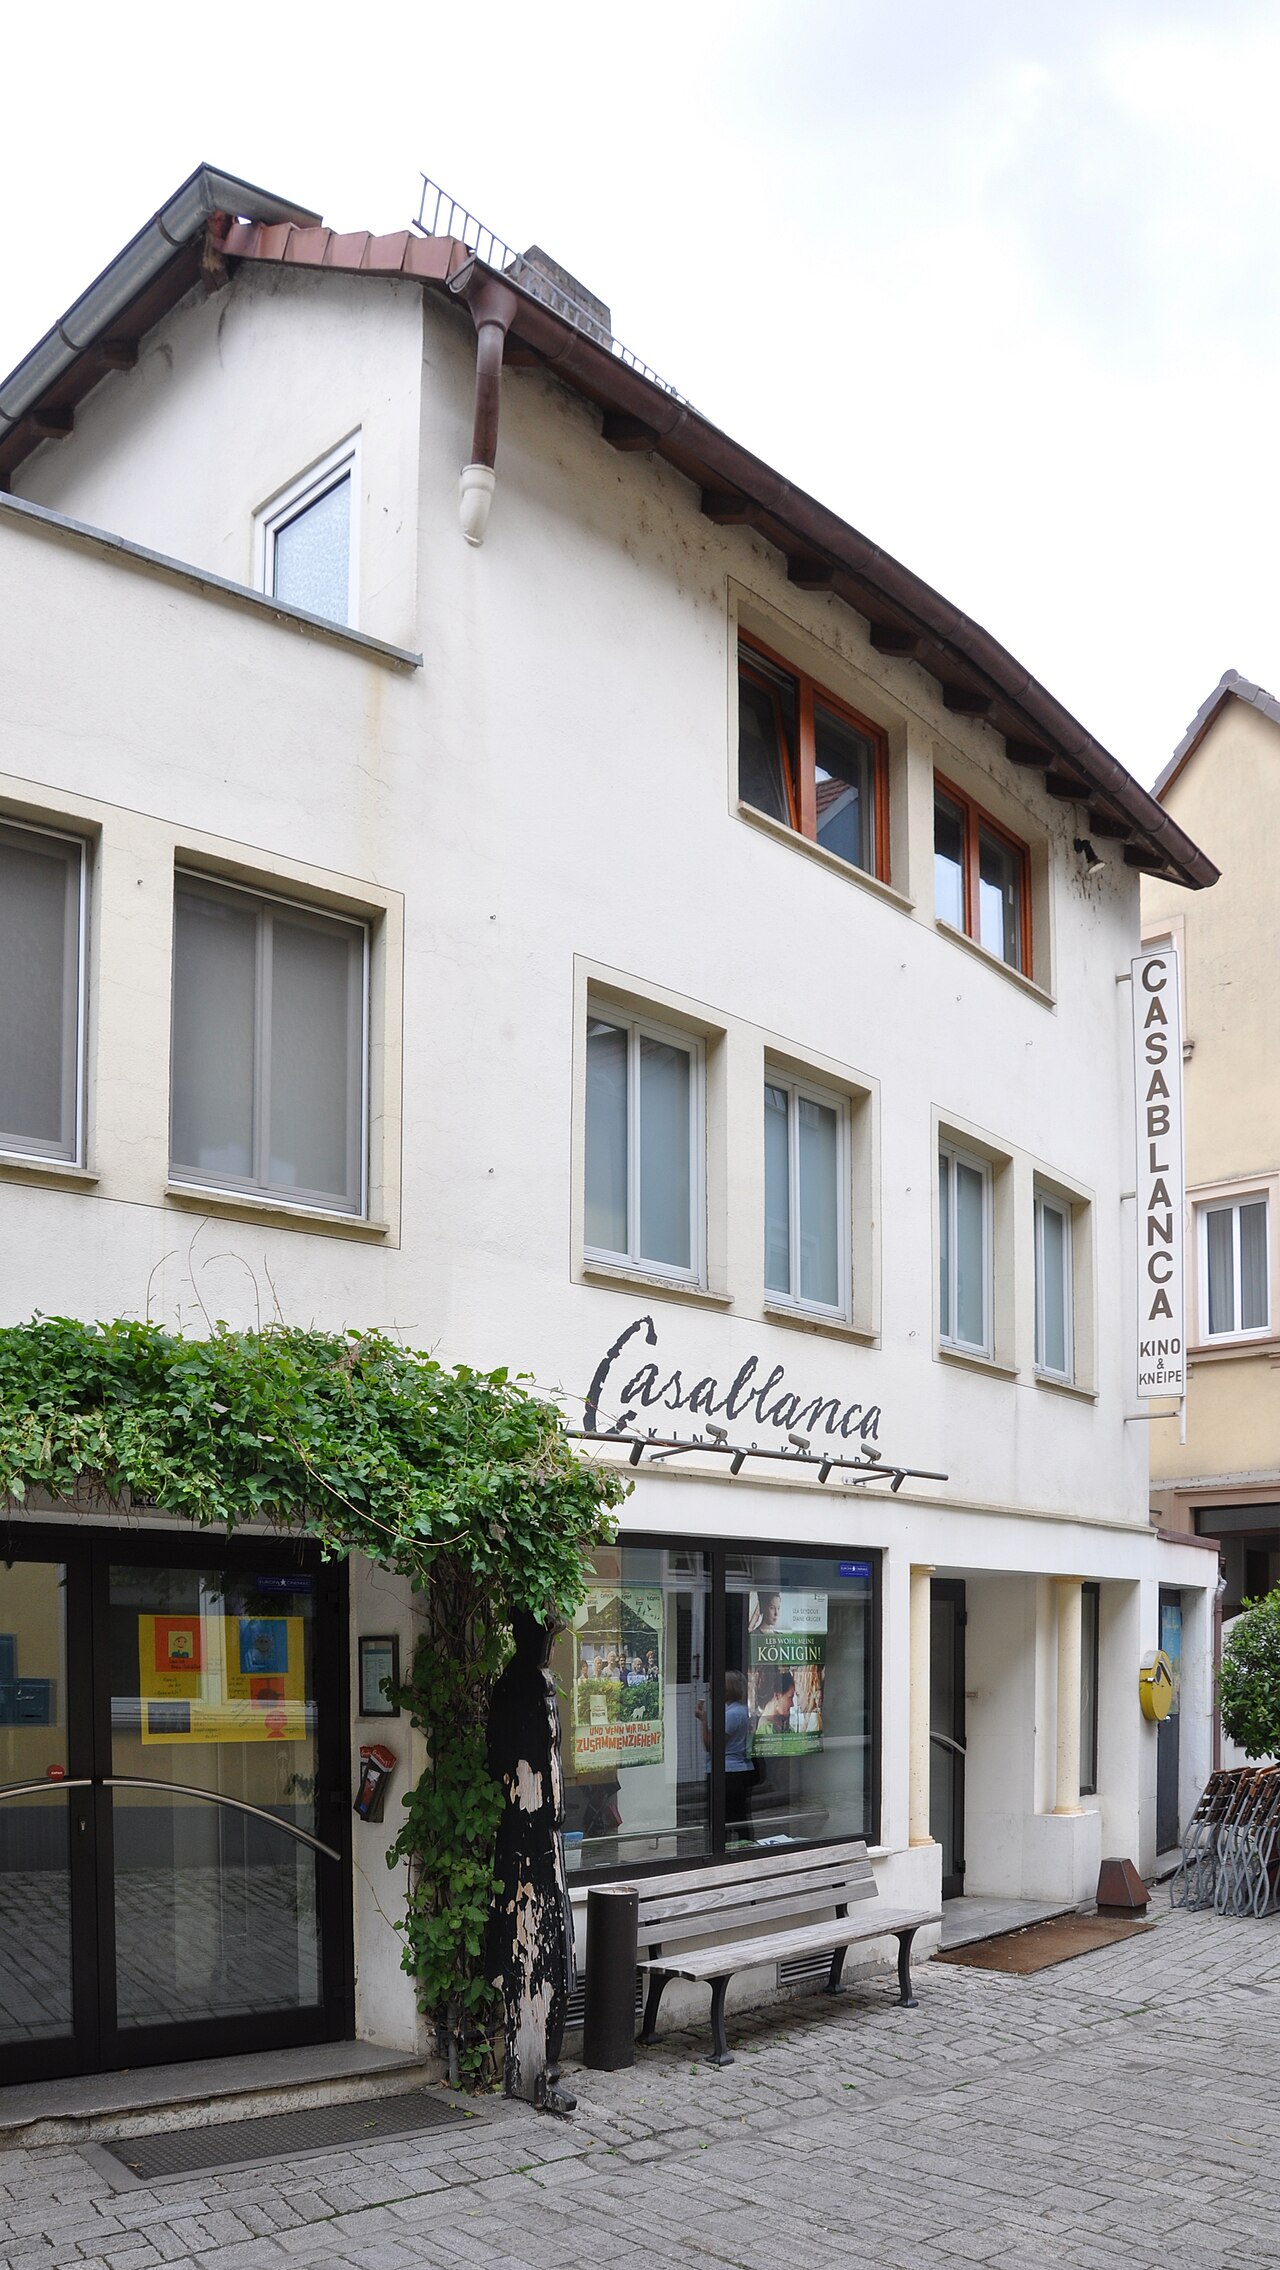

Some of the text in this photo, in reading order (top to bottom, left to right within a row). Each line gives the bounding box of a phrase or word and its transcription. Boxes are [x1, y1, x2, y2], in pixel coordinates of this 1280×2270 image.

[1141, 959, 1174, 1321] CASABLANCA
[1139, 1337, 1182, 1358] KINO
[1156, 1357, 1165, 1370] &
[583, 1315, 882, 1441] Casablanca
[1138, 1369, 1182, 1386] KNEIPE
[758, 1645, 821, 1661] KÖNIGIN!
[589, 1726, 604, 1736] UND
[605, 1725, 625, 1736] WENN
[625, 1723, 637, 1734] WIR
[576, 1731, 661, 1753] ZUSAMMENZIEHEN?
